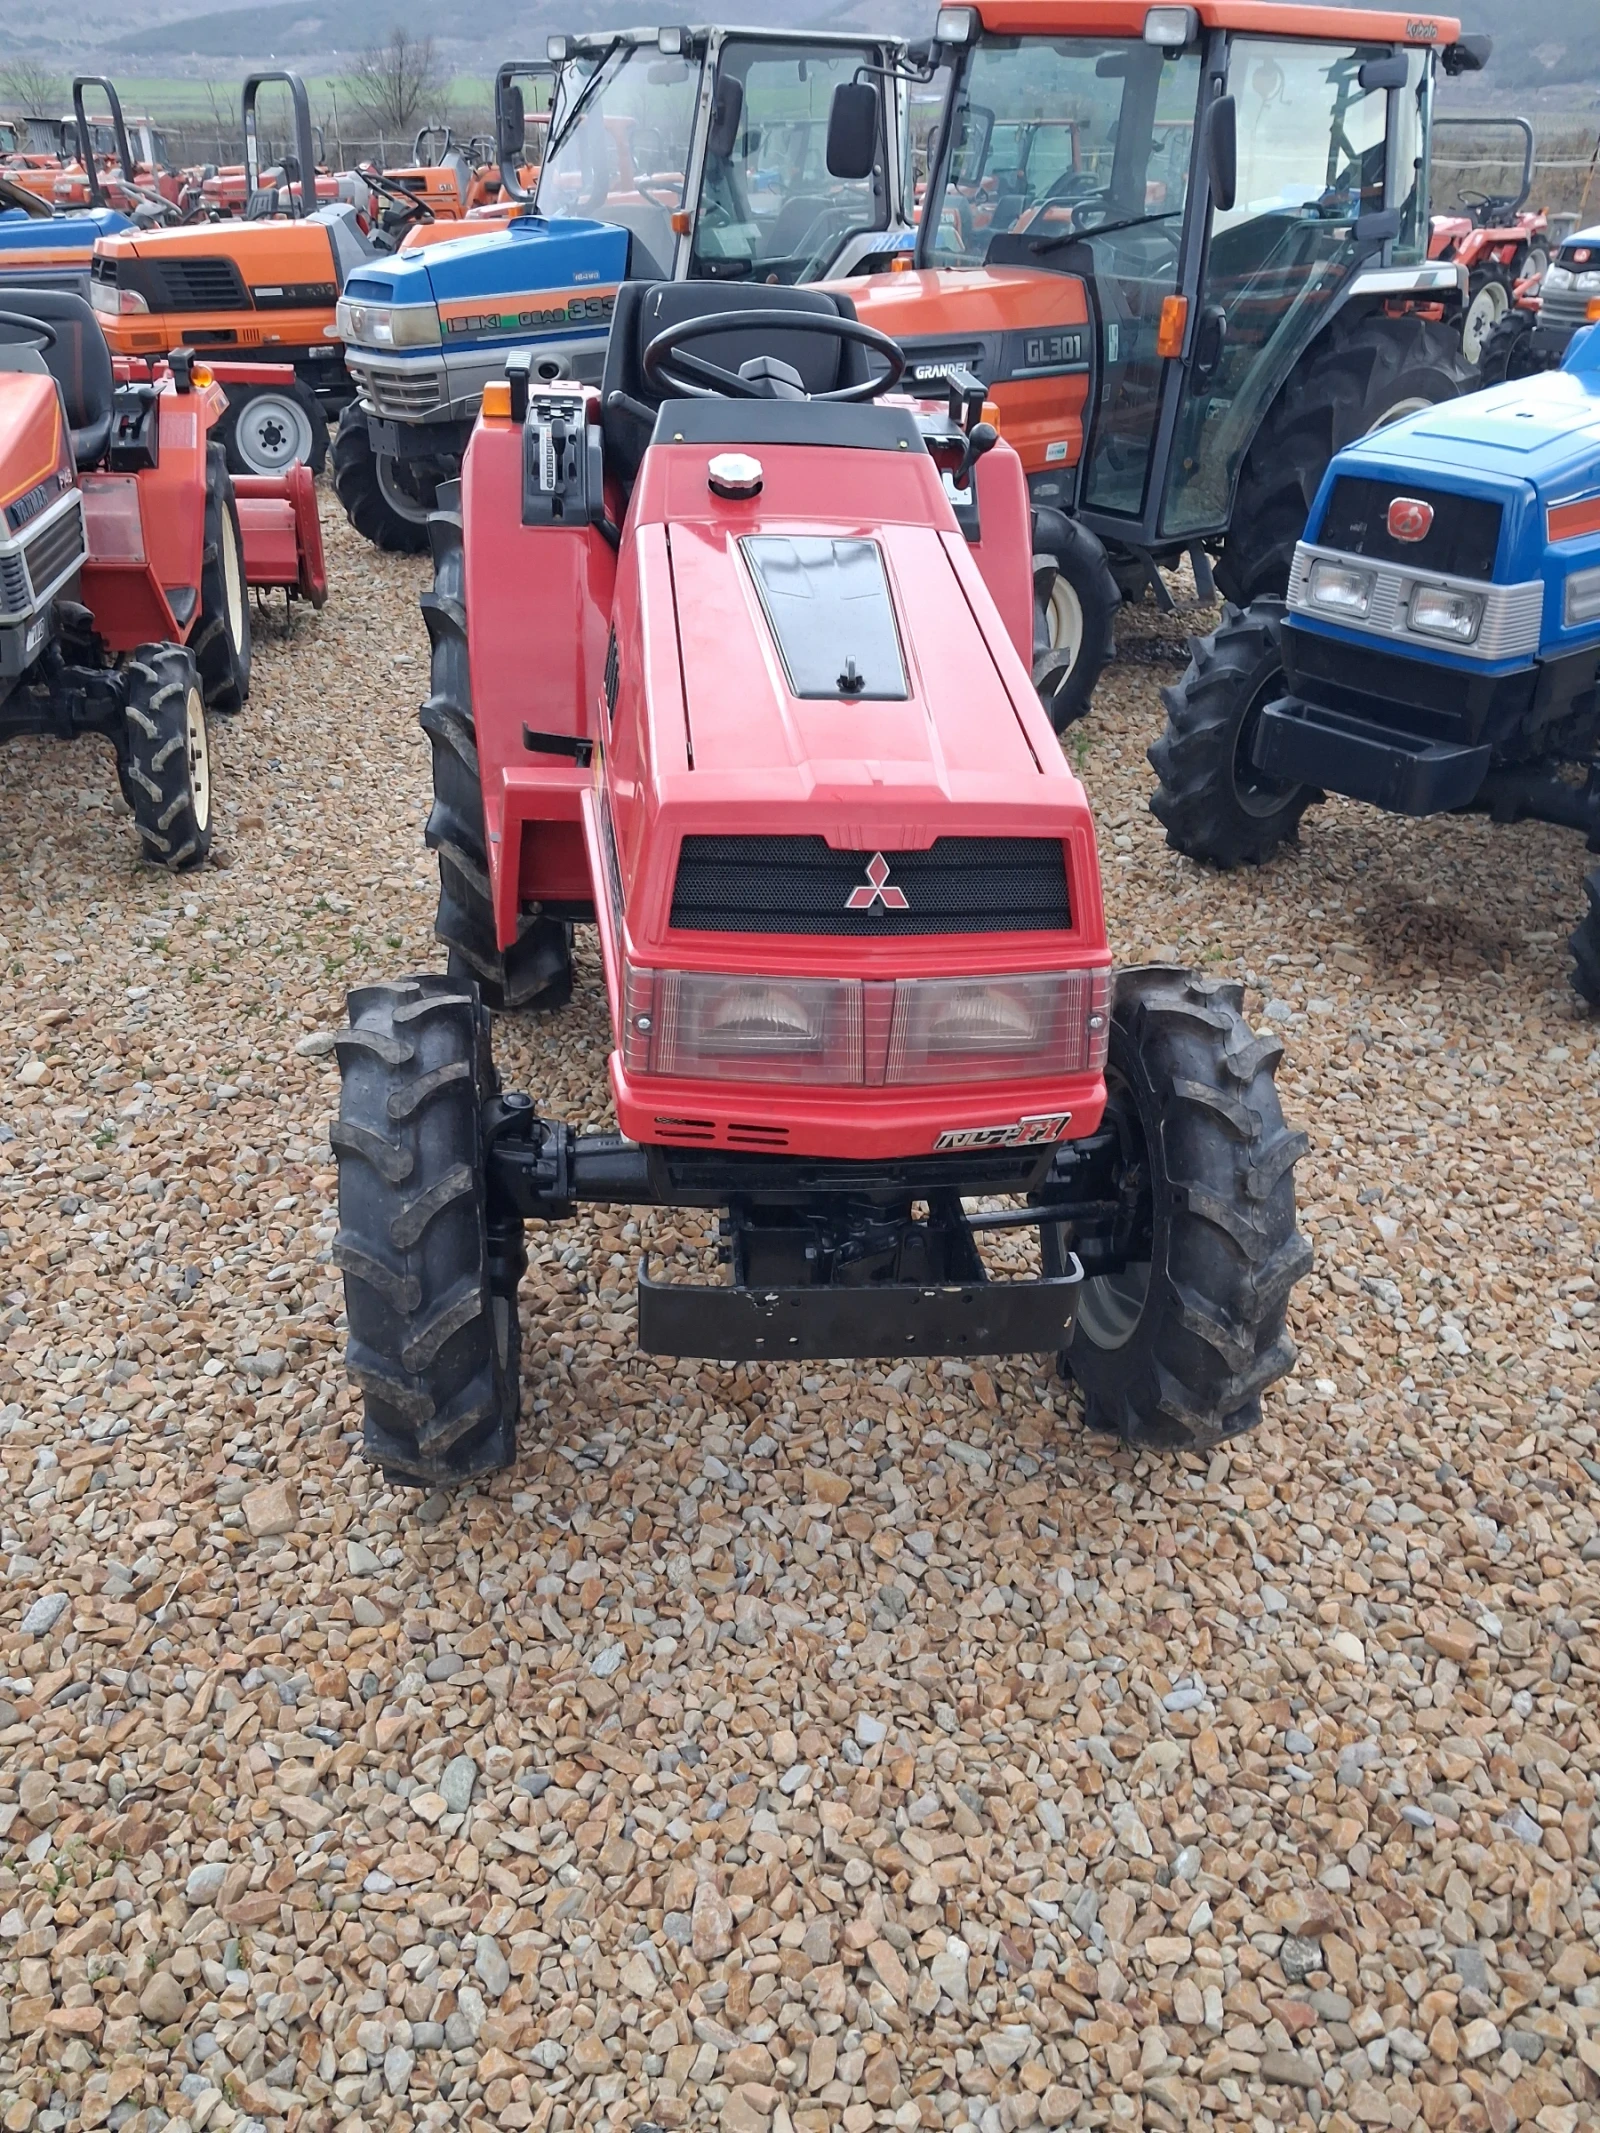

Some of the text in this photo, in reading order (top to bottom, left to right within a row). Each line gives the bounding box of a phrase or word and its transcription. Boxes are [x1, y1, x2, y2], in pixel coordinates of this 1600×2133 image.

[447, 314, 501, 333] ISEKI
[1027, 335, 1081, 363] GL301
[915, 362, 969, 380] GRANDEL
[11, 484, 49, 526] YANMAR
